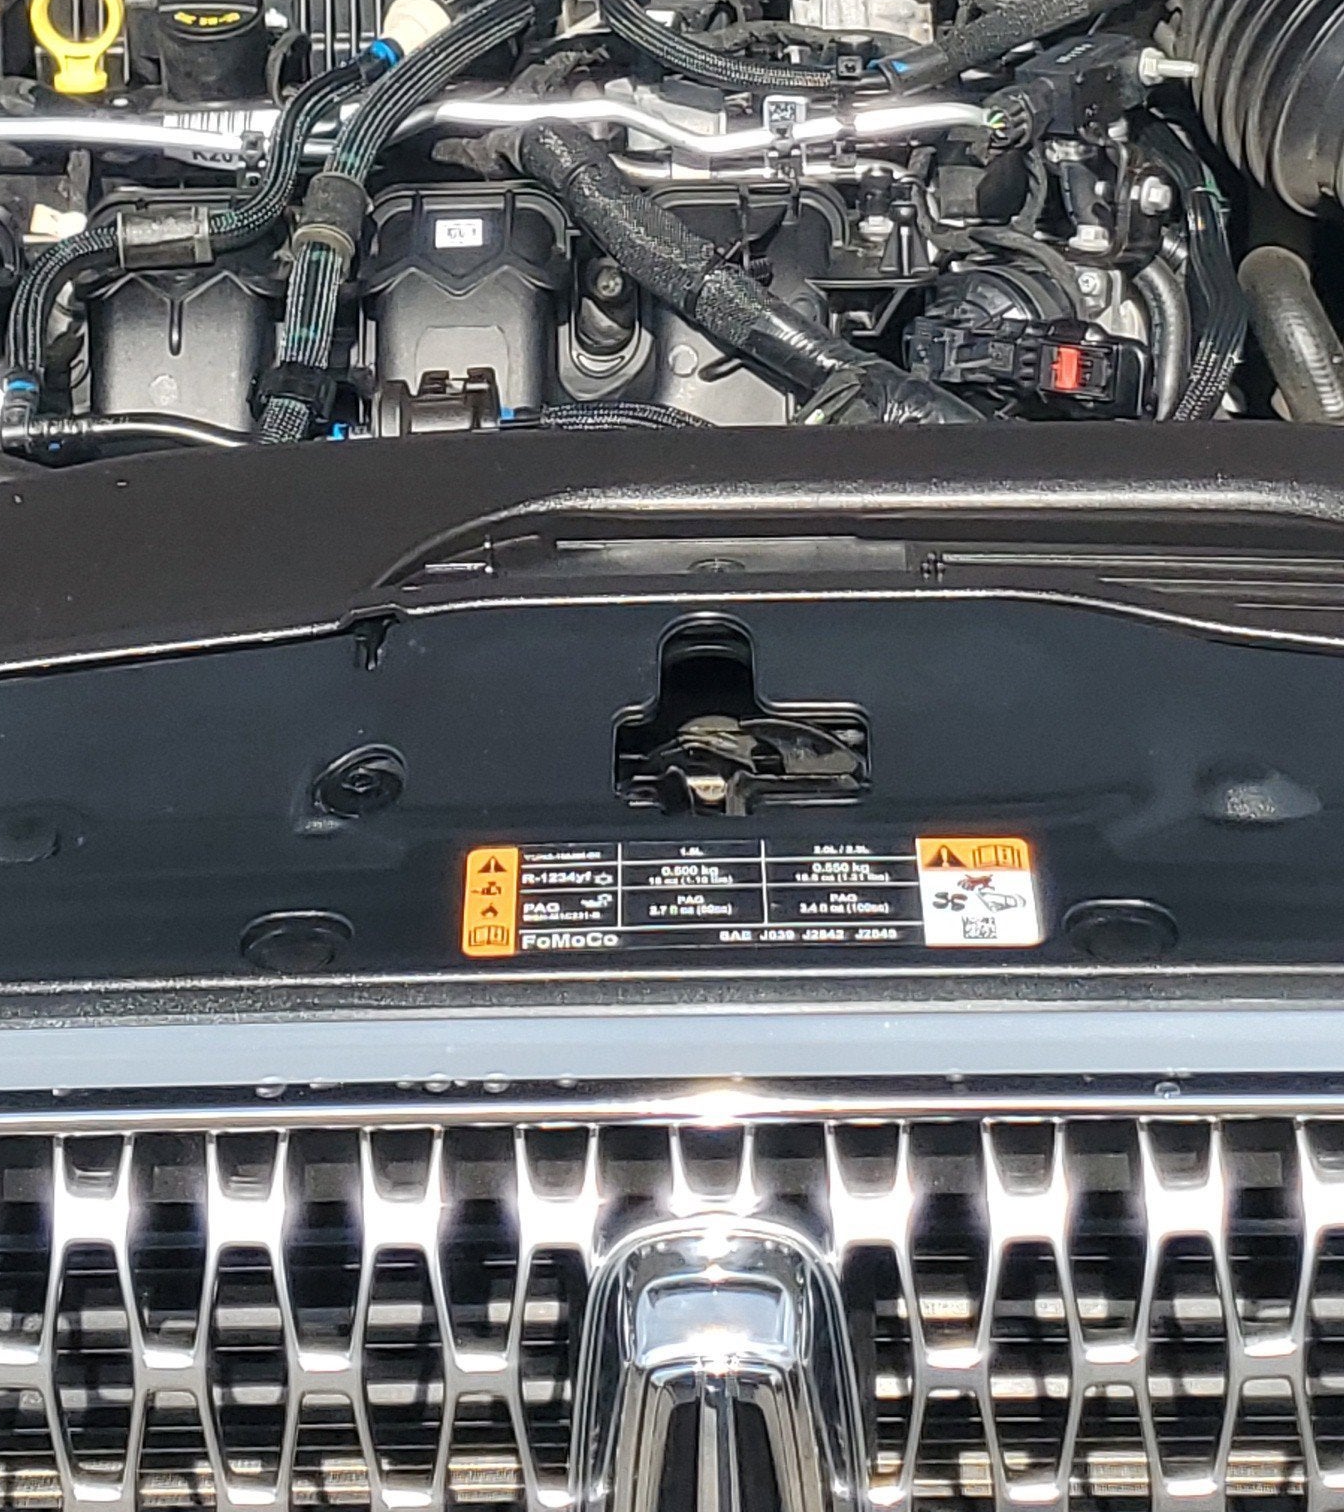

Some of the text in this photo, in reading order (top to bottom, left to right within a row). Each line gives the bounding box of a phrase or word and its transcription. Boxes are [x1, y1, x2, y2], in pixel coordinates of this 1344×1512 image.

[661, 865, 719, 878] 0.500 kg
[812, 862, 870, 876] 0.550 kg
[522, 870, 592, 885] R-1234yf
[523, 902, 560, 913] PAG
[522, 932, 619, 950] FoMoCo
